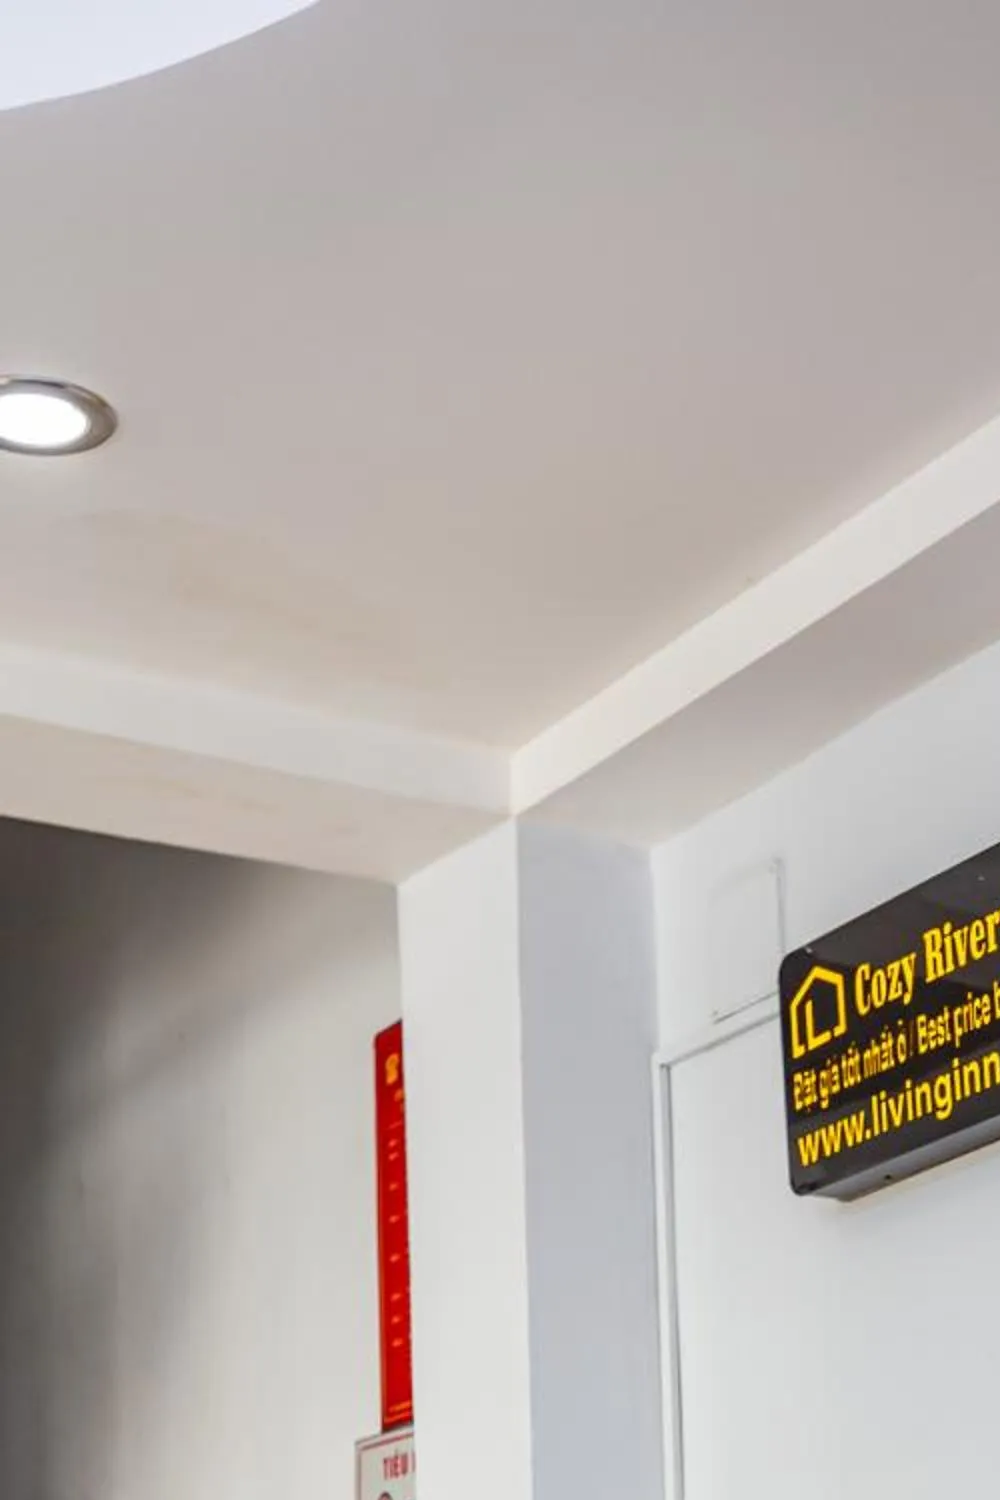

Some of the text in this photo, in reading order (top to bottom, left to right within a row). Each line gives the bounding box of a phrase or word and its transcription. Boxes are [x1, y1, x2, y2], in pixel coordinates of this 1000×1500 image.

[854, 951, 917, 1016] Cozy
[916, 1004, 952, 1055] Best
[953, 991, 991, 1048] price
